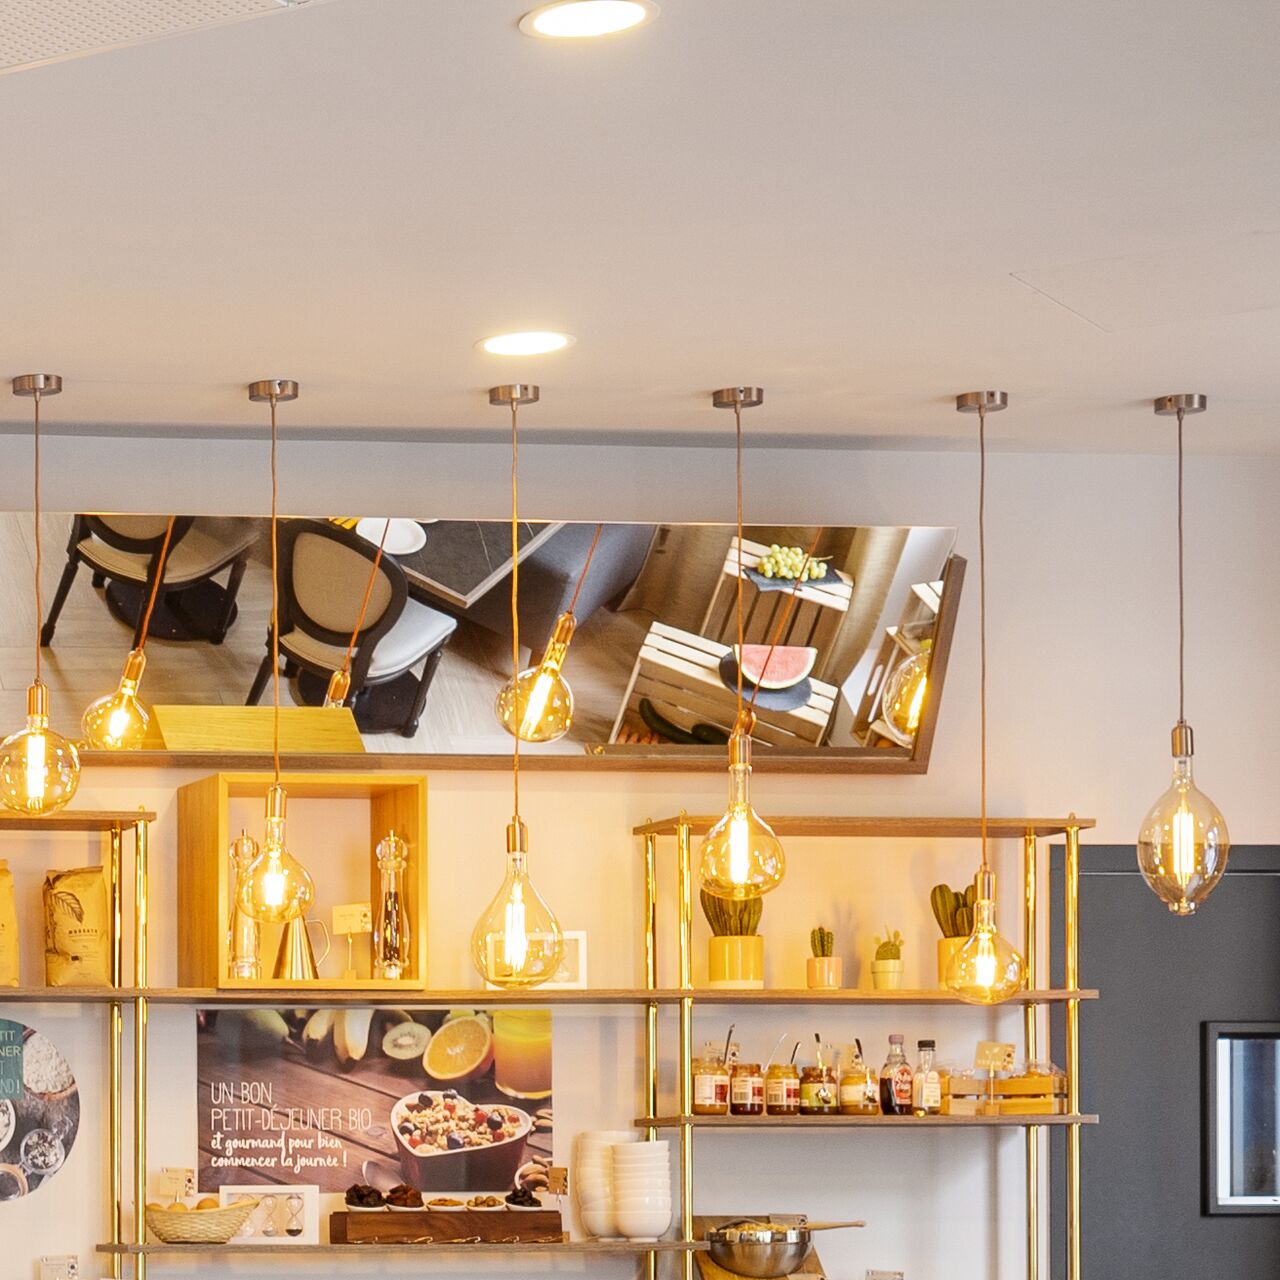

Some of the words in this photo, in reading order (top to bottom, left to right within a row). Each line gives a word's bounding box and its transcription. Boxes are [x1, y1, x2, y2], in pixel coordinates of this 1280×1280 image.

[210, 1082, 234, 1105] UN
[240, 1081, 273, 1104] BON
[210, 1103, 342, 1131] PETIT-DÉJEUNER
[348, 1107, 372, 1131] BIO
[210, 1131, 225, 1150] et
[225, 1130, 286, 1157] gourmand
[288, 1137, 314, 1155] pour
[317, 1131, 343, 1150] bien
[210, 1155, 278, 1168] commencer
[280, 1149, 294, 1167] la
[293, 1153, 339, 1174] journée
